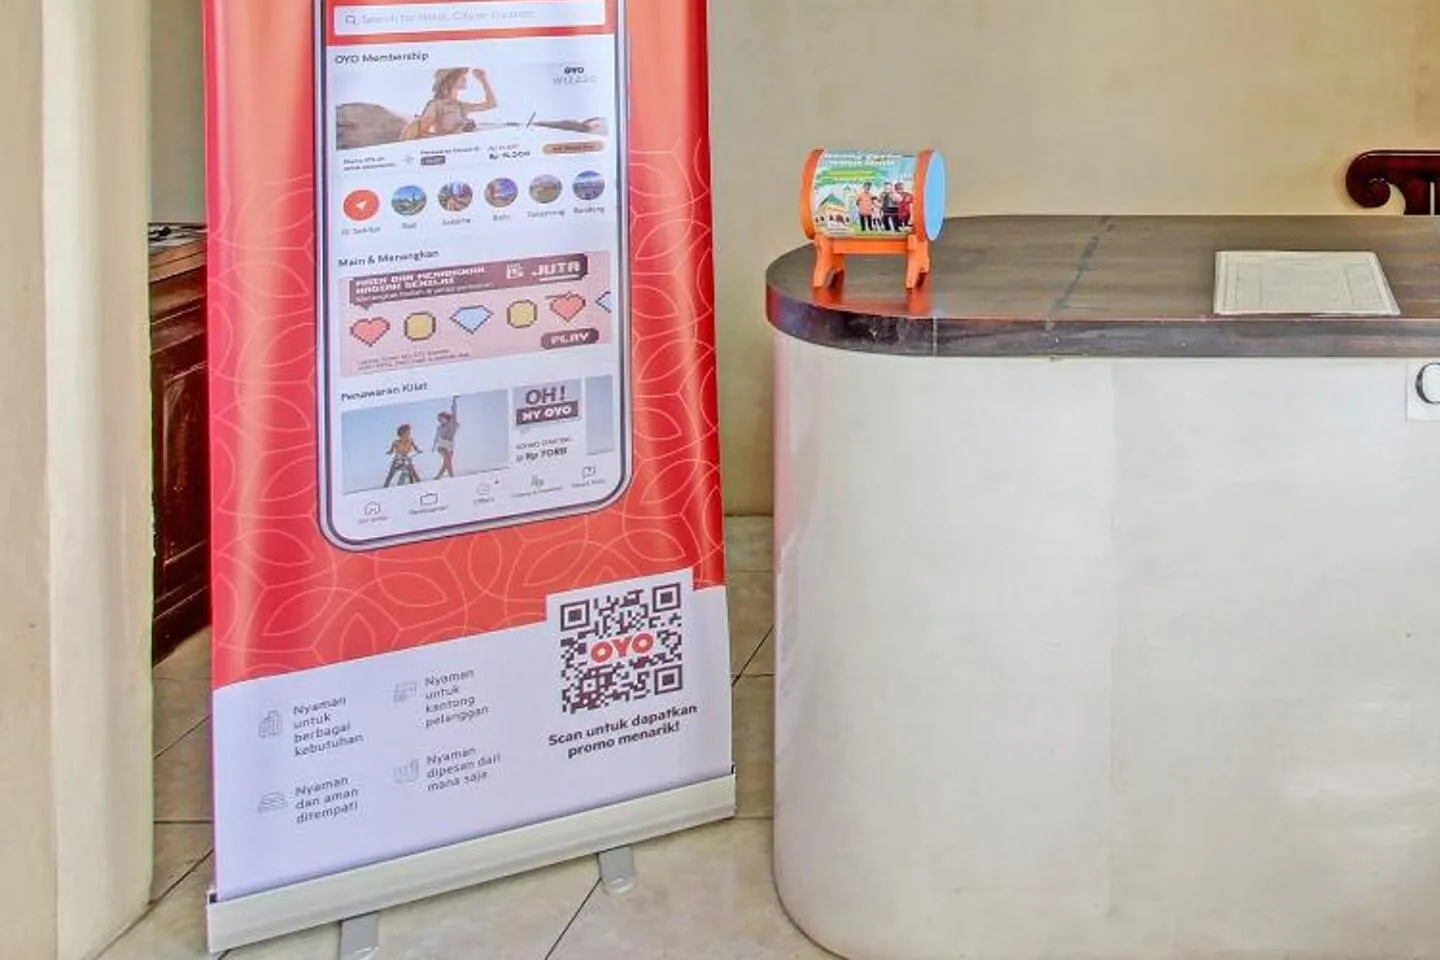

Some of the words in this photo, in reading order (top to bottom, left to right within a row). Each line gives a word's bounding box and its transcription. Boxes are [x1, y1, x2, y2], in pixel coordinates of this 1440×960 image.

[335, 54, 360, 65] OYO
[362, 50, 429, 65] Membership
[338, 256, 365, 267] Main
[368, 255, 375, 265] &
[378, 250, 440, 263] Menangkan
[532, 261, 580, 276] JUTA
[551, 331, 589, 344] PLAY
[341, 386, 400, 401] Penawaran
[403, 381, 428, 393] Kilat
[525, 385, 566, 405] OH!
[522, 409, 541, 421] MY
[544, 405, 572, 418] OYO
[591, 633, 654, 663] OYO
[424, 669, 475, 688] Nyaman
[424, 685, 460, 700] untuk
[293, 696, 347, 716] Nyaman
[424, 695, 476, 714] kantong
[293, 714, 332, 730] untuk
[424, 705, 489, 729] pelanggan
[548, 730, 583, 746] Scan
[586, 719, 628, 737] untuk
[631, 703, 697, 727] dapatkan
[293, 722, 351, 744] berbagai
[568, 736, 615, 759] promo
[617, 721, 680, 745] menarik!
[294, 733, 364, 757] kebutuhan
[426, 747, 476, 766] Nyaman
[426, 760, 475, 779] dipesan
[295, 776, 349, 797] Nyaman
[427, 776, 461, 791] mana
[464, 770, 488, 786] saja
[295, 793, 320, 810] dan
[324, 788, 359, 803] aman
[296, 801, 358, 824] ditempati
